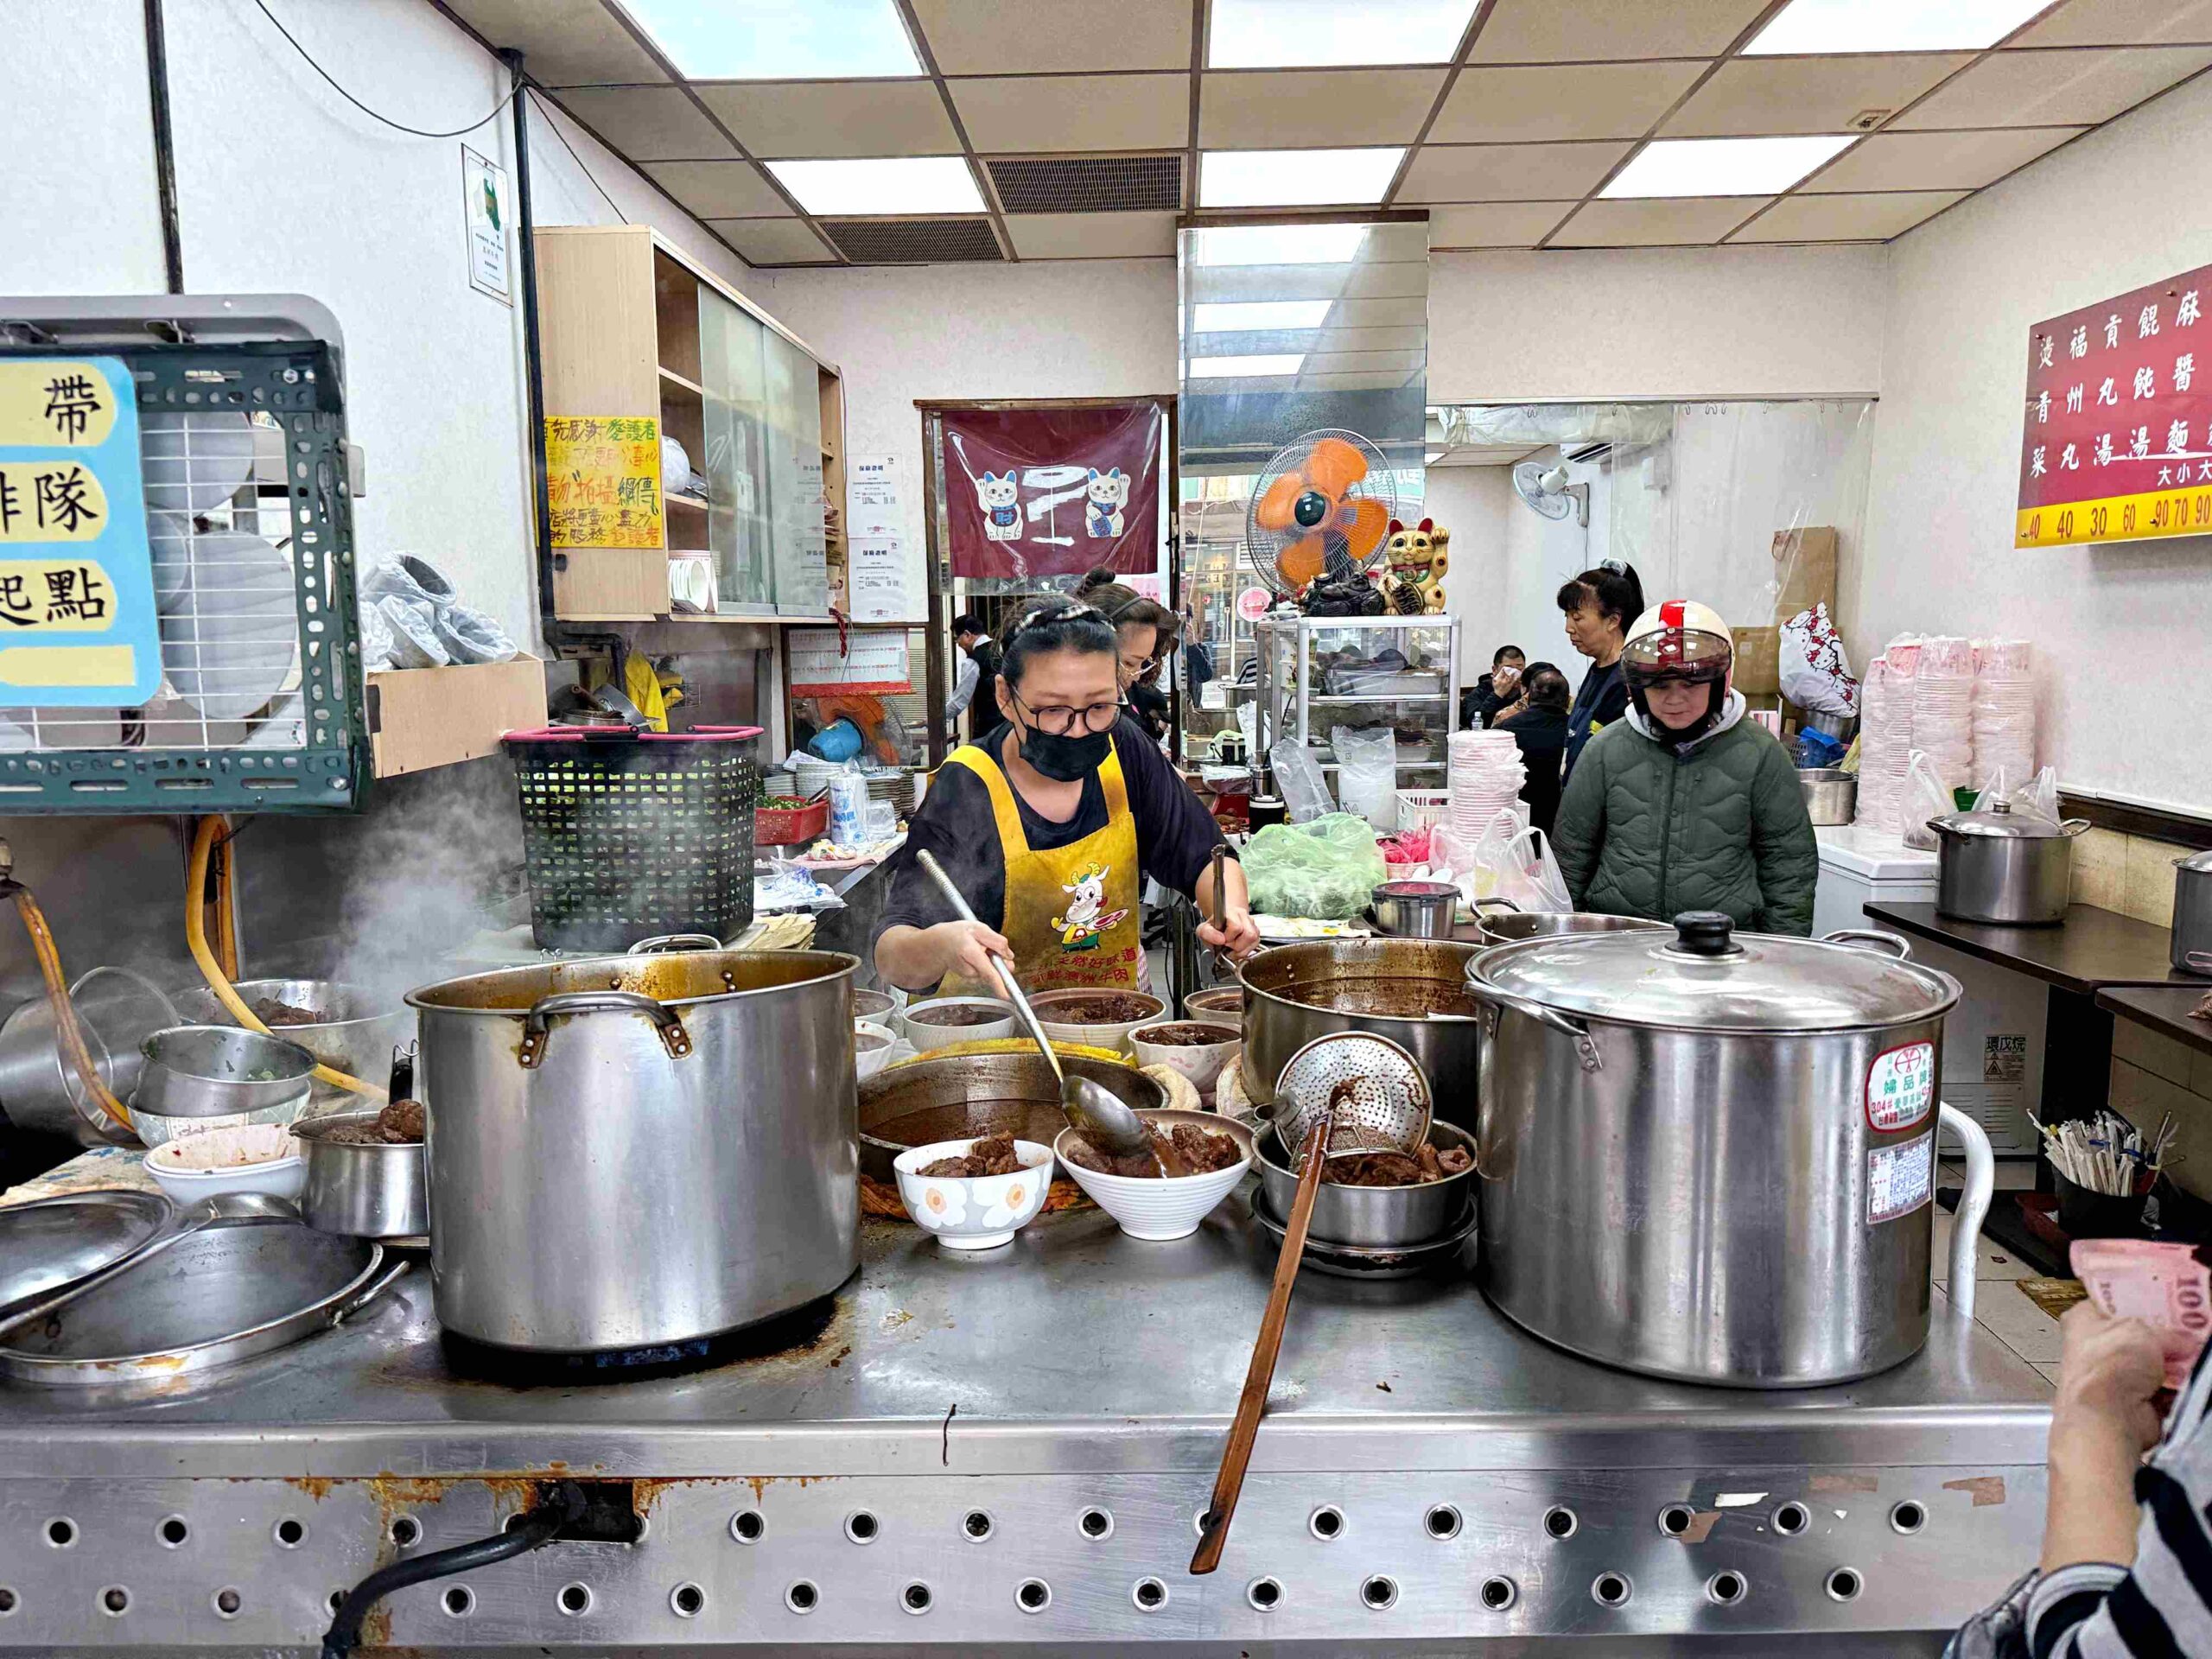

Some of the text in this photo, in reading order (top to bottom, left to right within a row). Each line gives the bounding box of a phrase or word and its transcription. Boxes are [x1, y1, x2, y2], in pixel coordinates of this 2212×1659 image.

[2030, 335, 2055, 479] 燙青菜
[2060, 324, 2088, 470] 福州丸
[2093, 315, 2122, 466] 貢丸湯
[2129, 305, 2159, 461] 餛飩湯
[2166, 290, 2202, 455] 麻醬麵
[43, 373, 103, 445] 帶
[2158, 459, 2212, 486] 大 小 大
[995, 512, 1014, 524] 財
[2029, 494, 2211, 541] 40 40 30 60 90 70 90
[0, 566, 105, 627] 起點
[1058, 947, 1137, 969] 天然好味道
